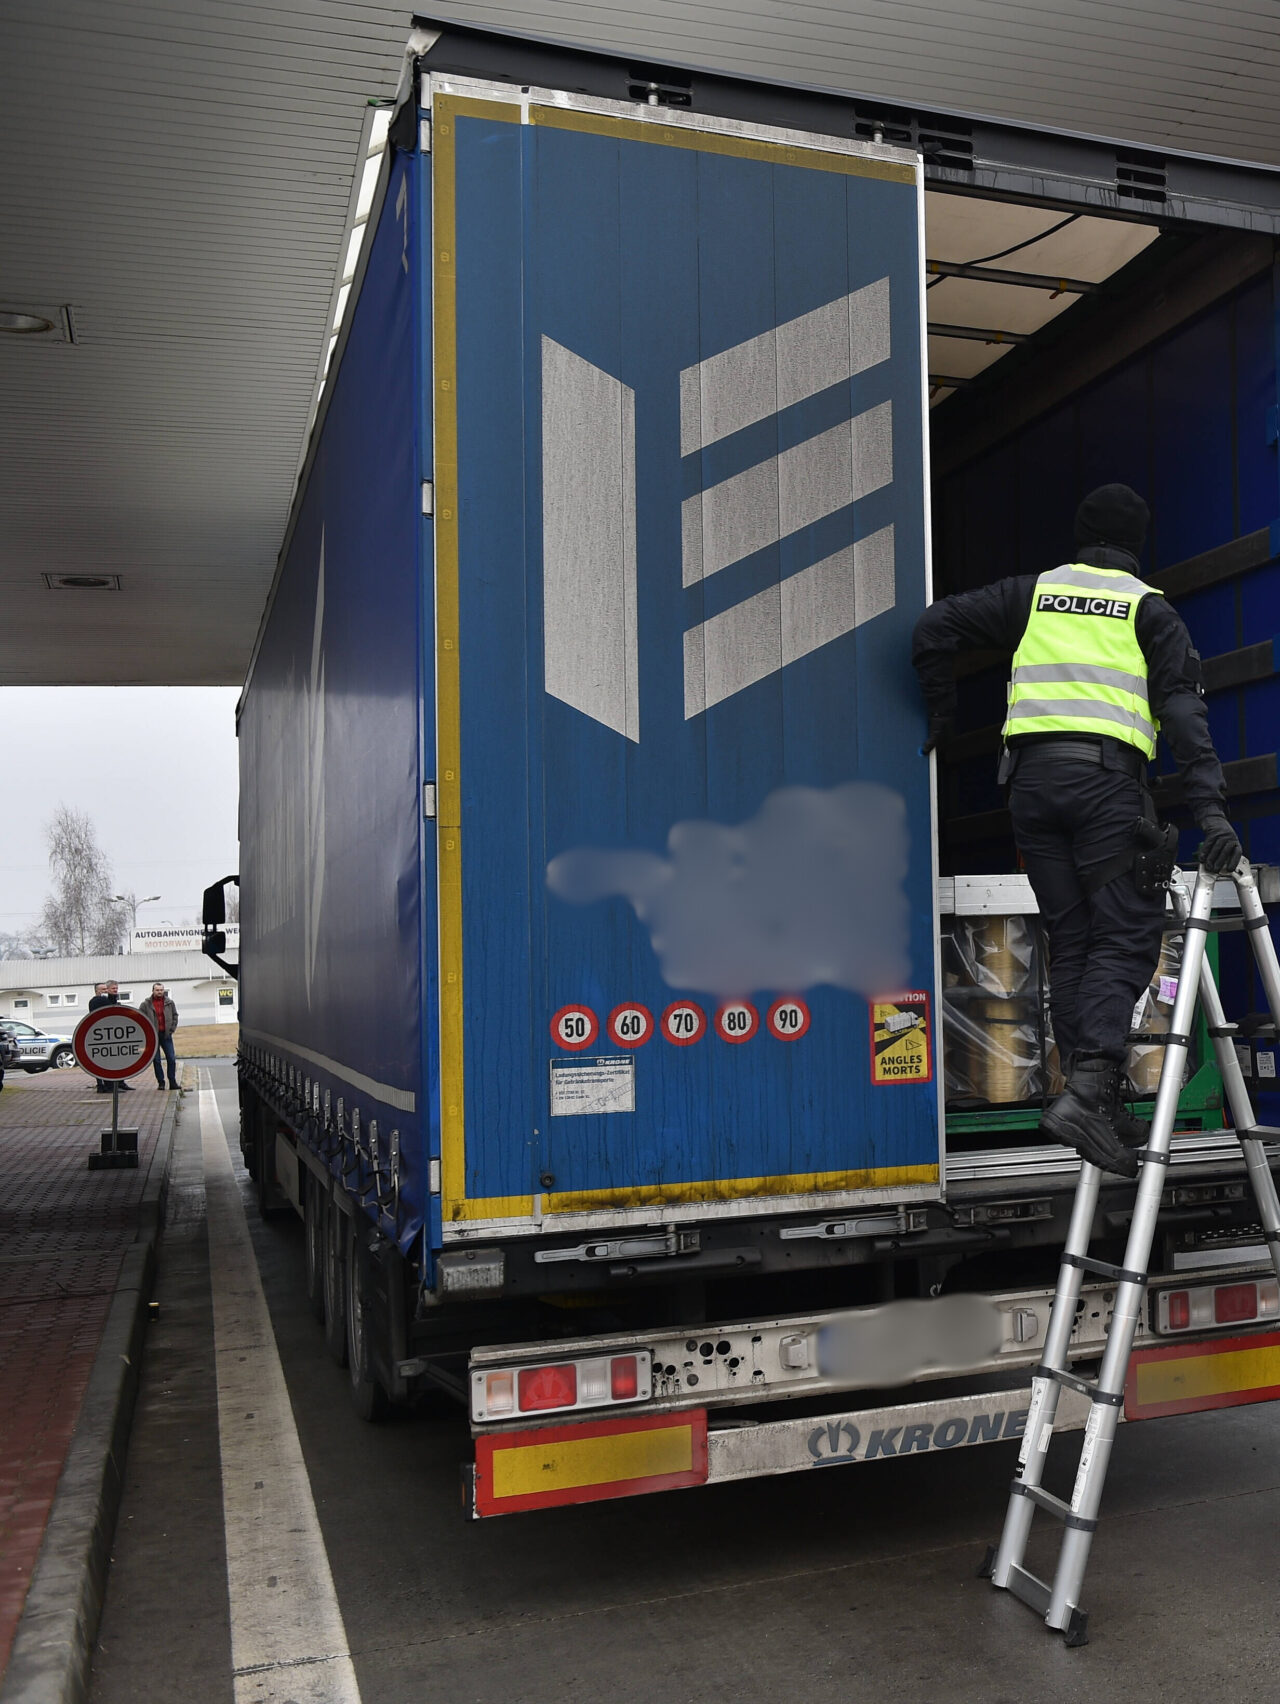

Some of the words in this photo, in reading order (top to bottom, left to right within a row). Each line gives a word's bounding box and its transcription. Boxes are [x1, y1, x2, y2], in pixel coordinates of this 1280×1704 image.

[1038, 595, 1129, 618] POLICIE
[564, 1017, 585, 1038] 50
[620, 1015, 641, 1035] 60
[673, 1013, 694, 1033] 70
[727, 1011, 746, 1031] 80
[779, 1009, 798, 1029] 90
[93, 1025, 136, 1041] STOP
[92, 1044, 140, 1058] POLICIE
[880, 1055, 922, 1066] ANGLES
[882, 1065, 921, 1075] MORTS
[864, 1408, 1029, 1459] KRONE
